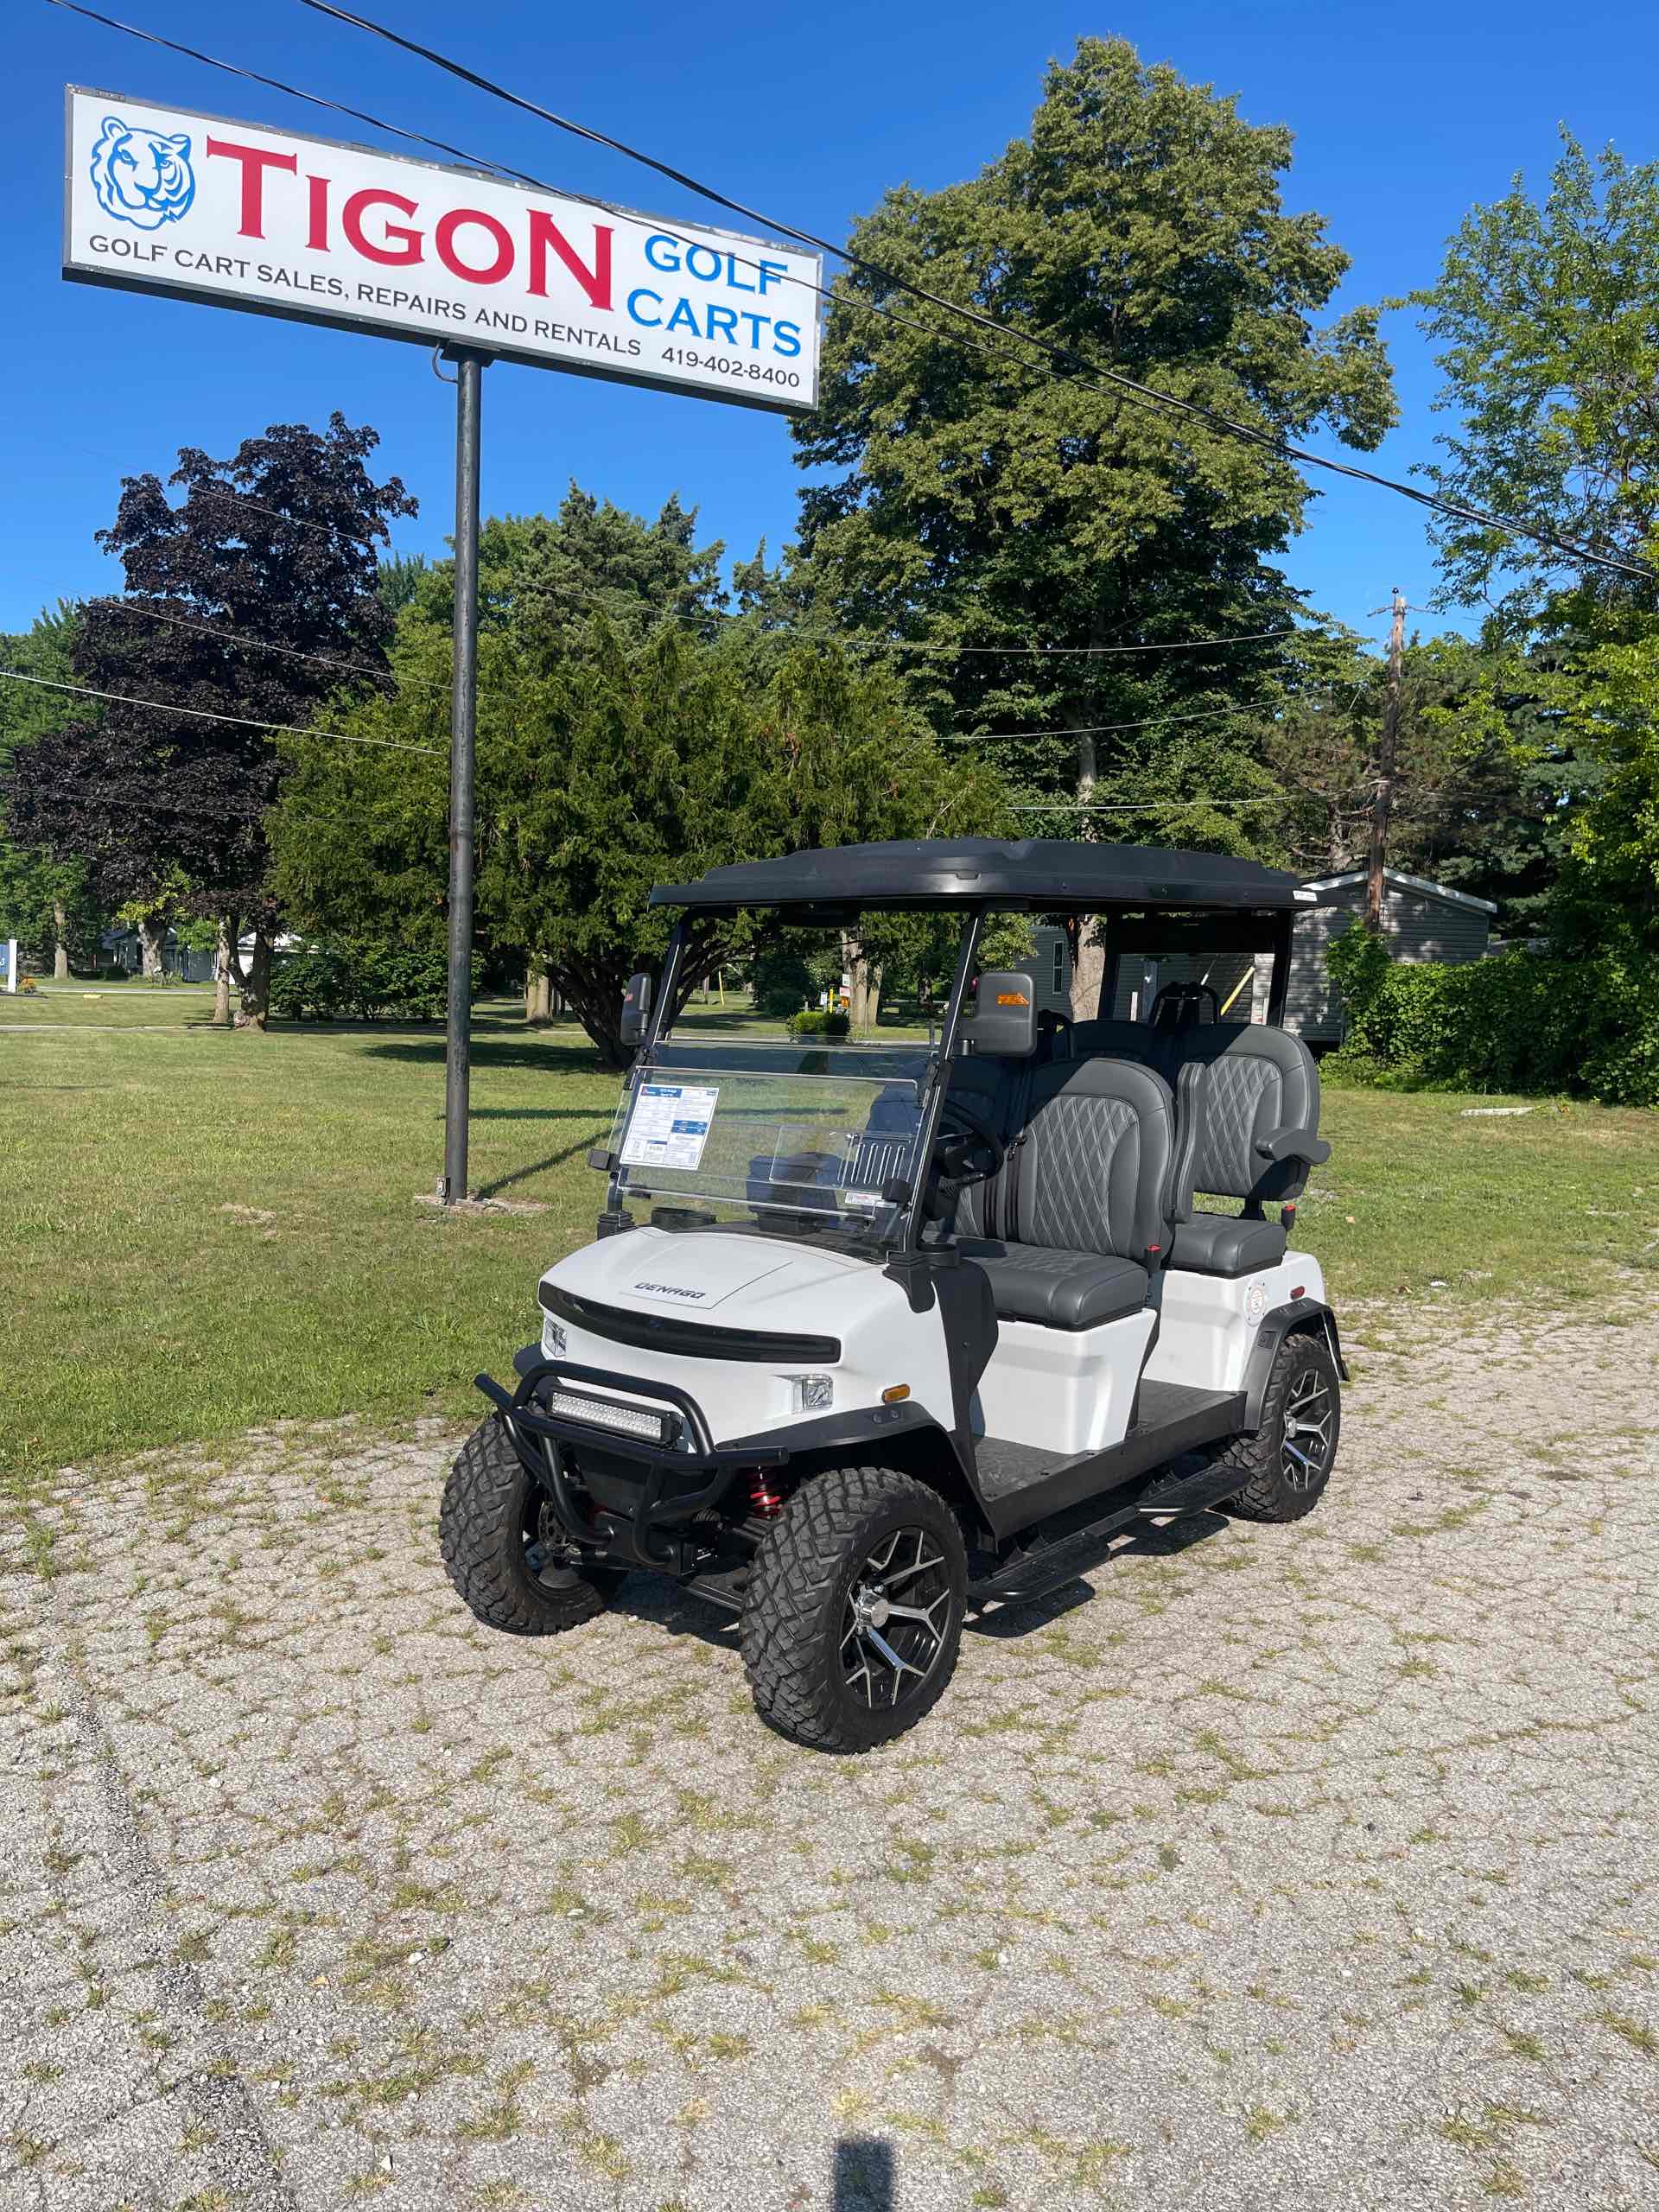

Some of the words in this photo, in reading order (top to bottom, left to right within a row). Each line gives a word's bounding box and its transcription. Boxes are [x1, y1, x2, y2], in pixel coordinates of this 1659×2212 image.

[207, 134, 614, 311] TIGON
[89, 234, 168, 262] GOLF
[174, 249, 251, 278] CART
[257, 264, 350, 302] SALES,
[357, 283, 467, 321] REPAIRS
[474, 308, 528, 333] AND
[534, 321, 641, 356] RENTALS
[644, 234, 788, 296] GOLF
[627, 289, 801, 358] CARTS
[661, 346, 800, 388] 419-402-8400
[634, 1282, 706, 1299] DENAGO
